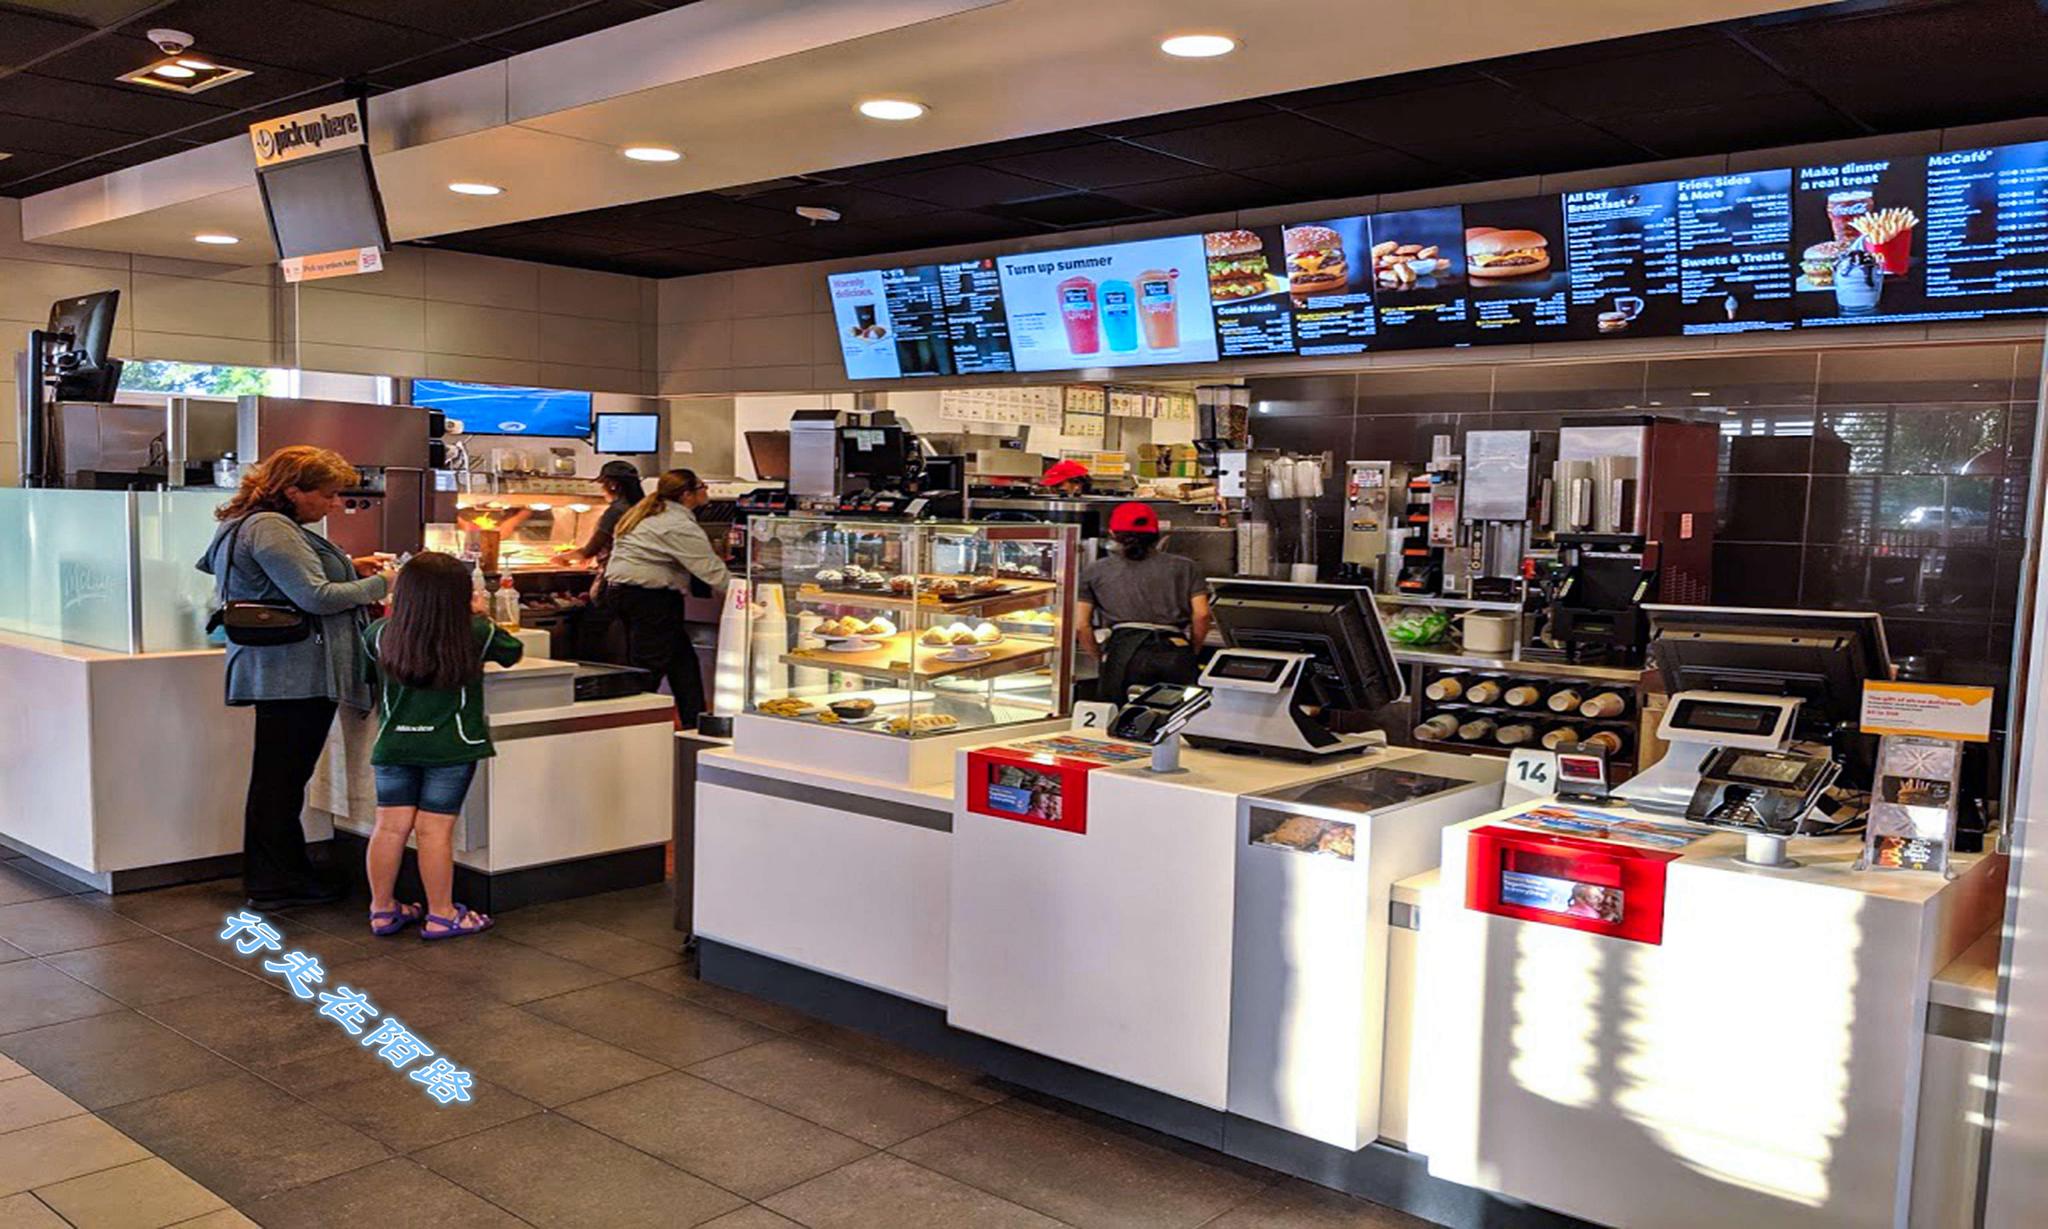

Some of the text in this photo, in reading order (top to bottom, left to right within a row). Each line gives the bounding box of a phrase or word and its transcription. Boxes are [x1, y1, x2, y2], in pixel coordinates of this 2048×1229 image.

[274, 113, 358, 155] pick up here
[1800, 161, 1890, 179] Make dinner
[1678, 176, 1752, 191] Fries, Sides
[1801, 173, 1879, 190] a real treat
[1568, 192, 1609, 203] All Day
[1679, 190, 1725, 201] & More
[1568, 200, 1626, 213] Breakfast
[1005, 255, 1113, 276] Turn up summer
[1681, 252, 1786, 268] Sweets & Treats
[1218, 304, 1277, 316] Combo Meals
[1084, 711, 1097, 728] 2
[1516, 760, 1548, 784] 14
